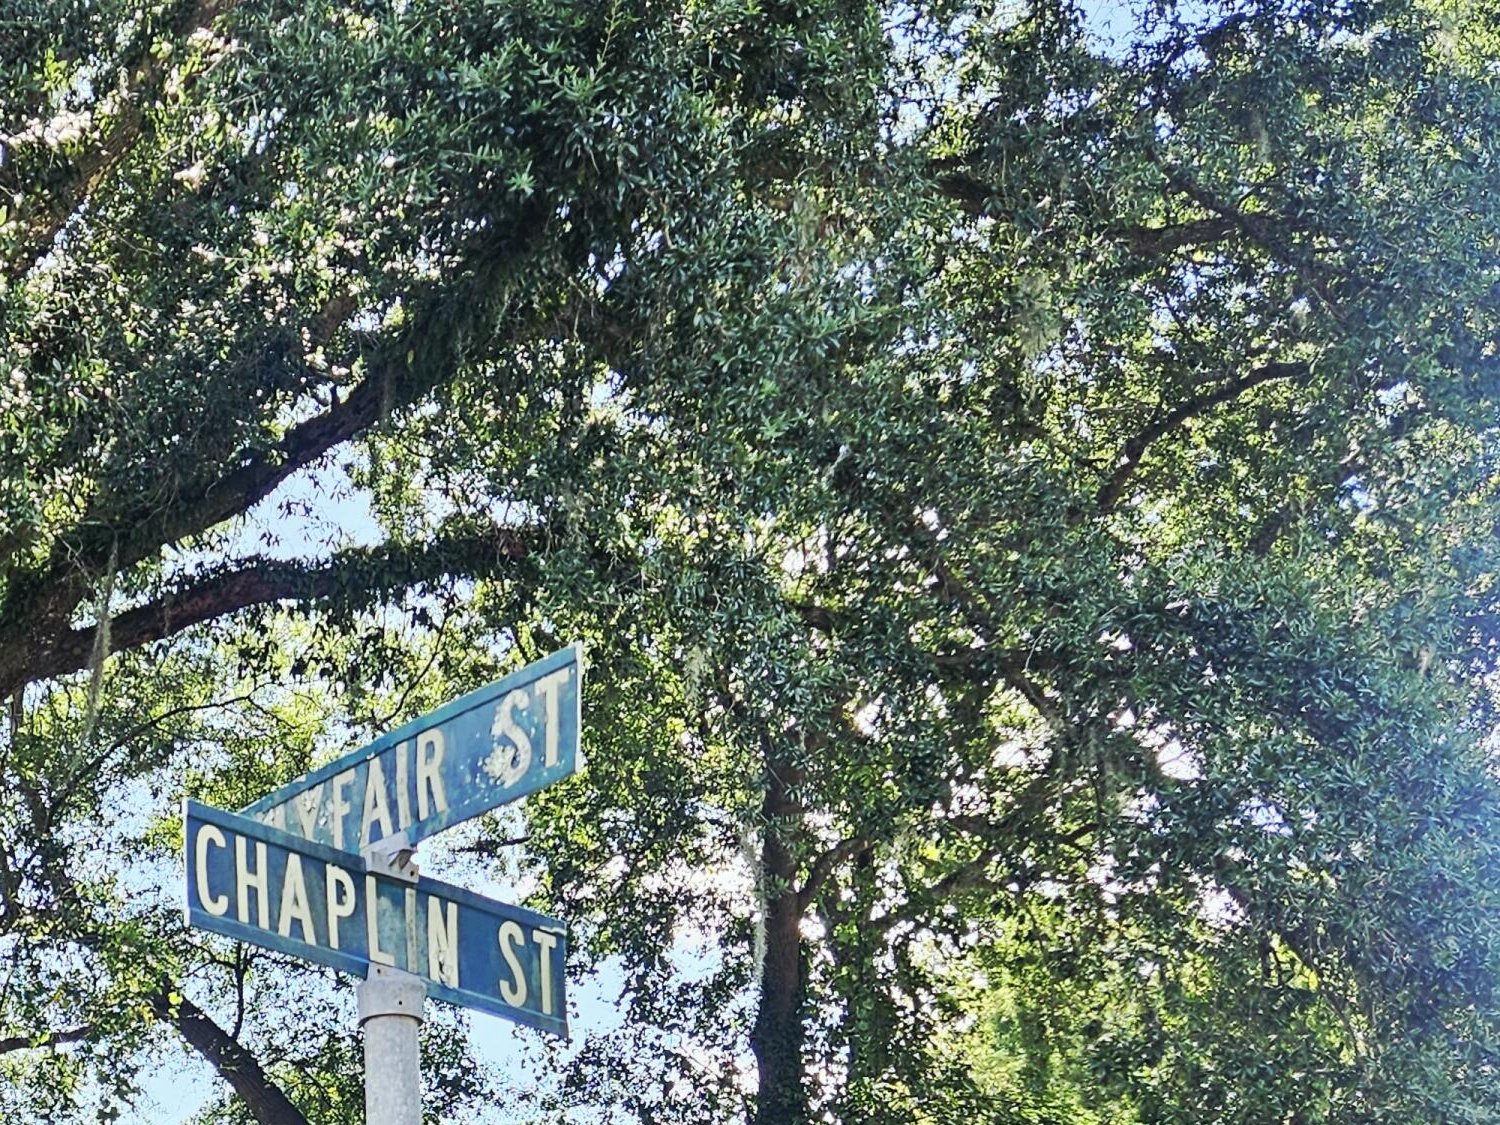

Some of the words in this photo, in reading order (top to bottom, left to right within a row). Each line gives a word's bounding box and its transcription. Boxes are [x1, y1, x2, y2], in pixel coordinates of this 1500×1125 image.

[485, 667, 570, 789] ST
[195, 824, 460, 989] CHAPLIN
[498, 920, 557, 1016] ST
